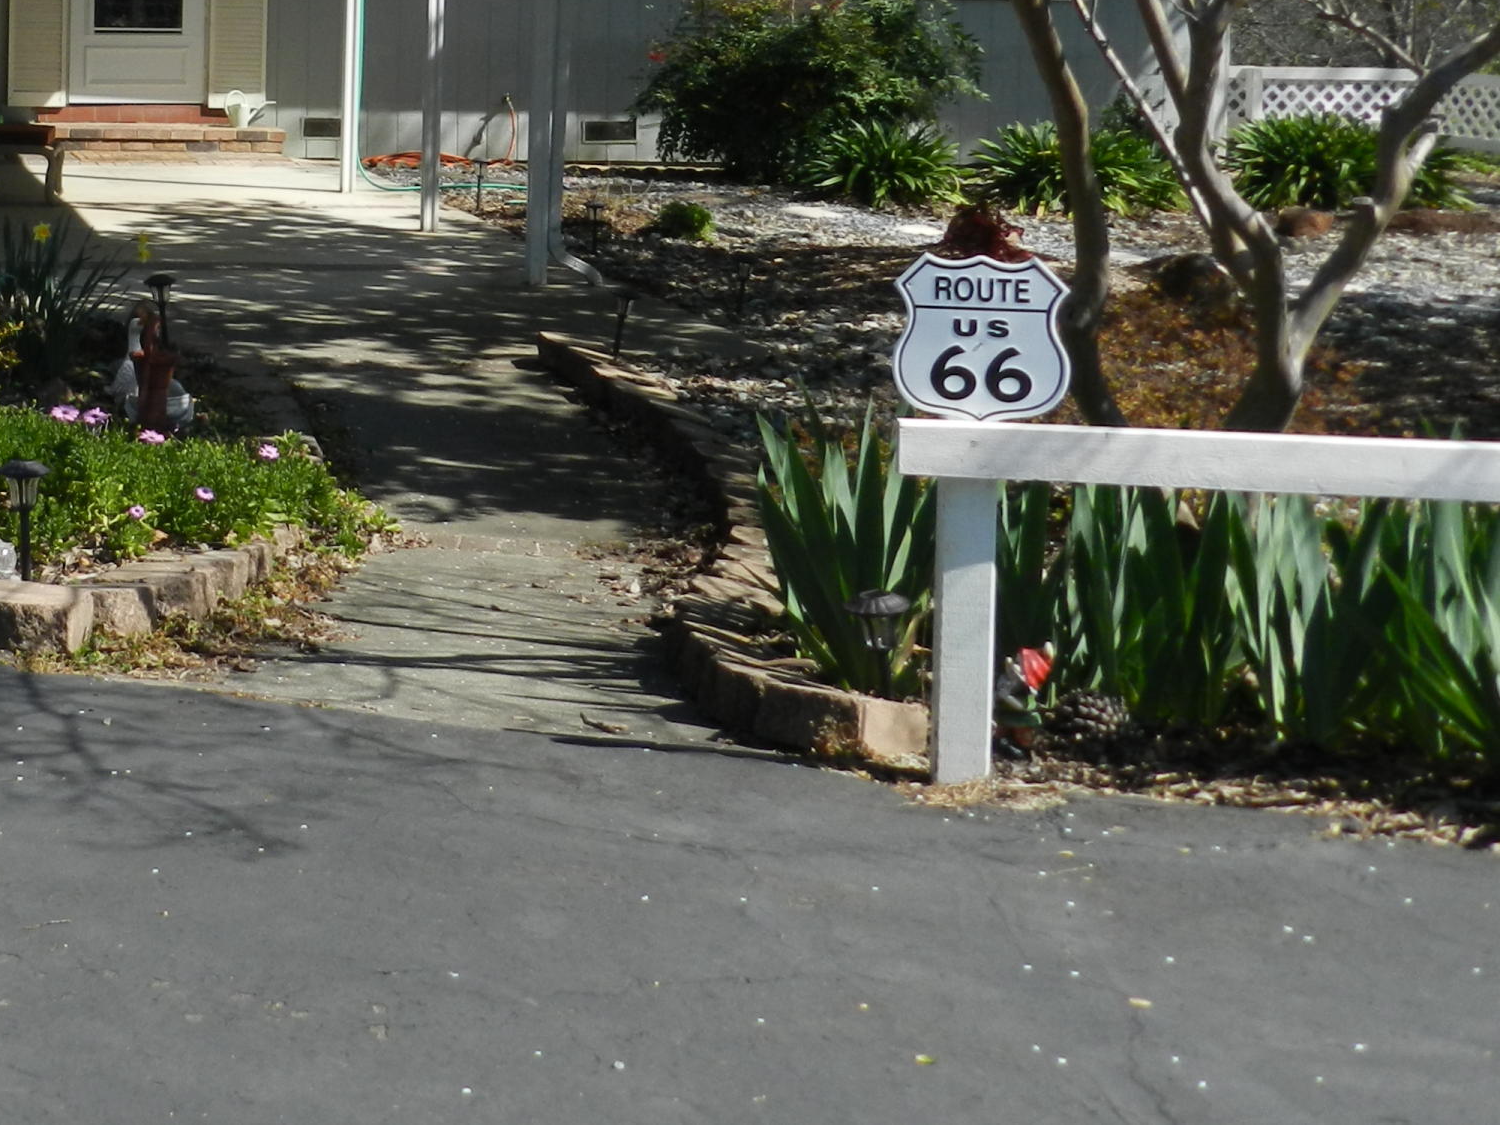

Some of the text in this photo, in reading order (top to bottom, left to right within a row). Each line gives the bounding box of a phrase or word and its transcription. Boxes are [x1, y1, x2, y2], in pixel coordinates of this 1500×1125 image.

[934, 276, 1030, 303] ROUTE
[953, 319, 1009, 338] US
[930, 345, 1032, 403] 66
